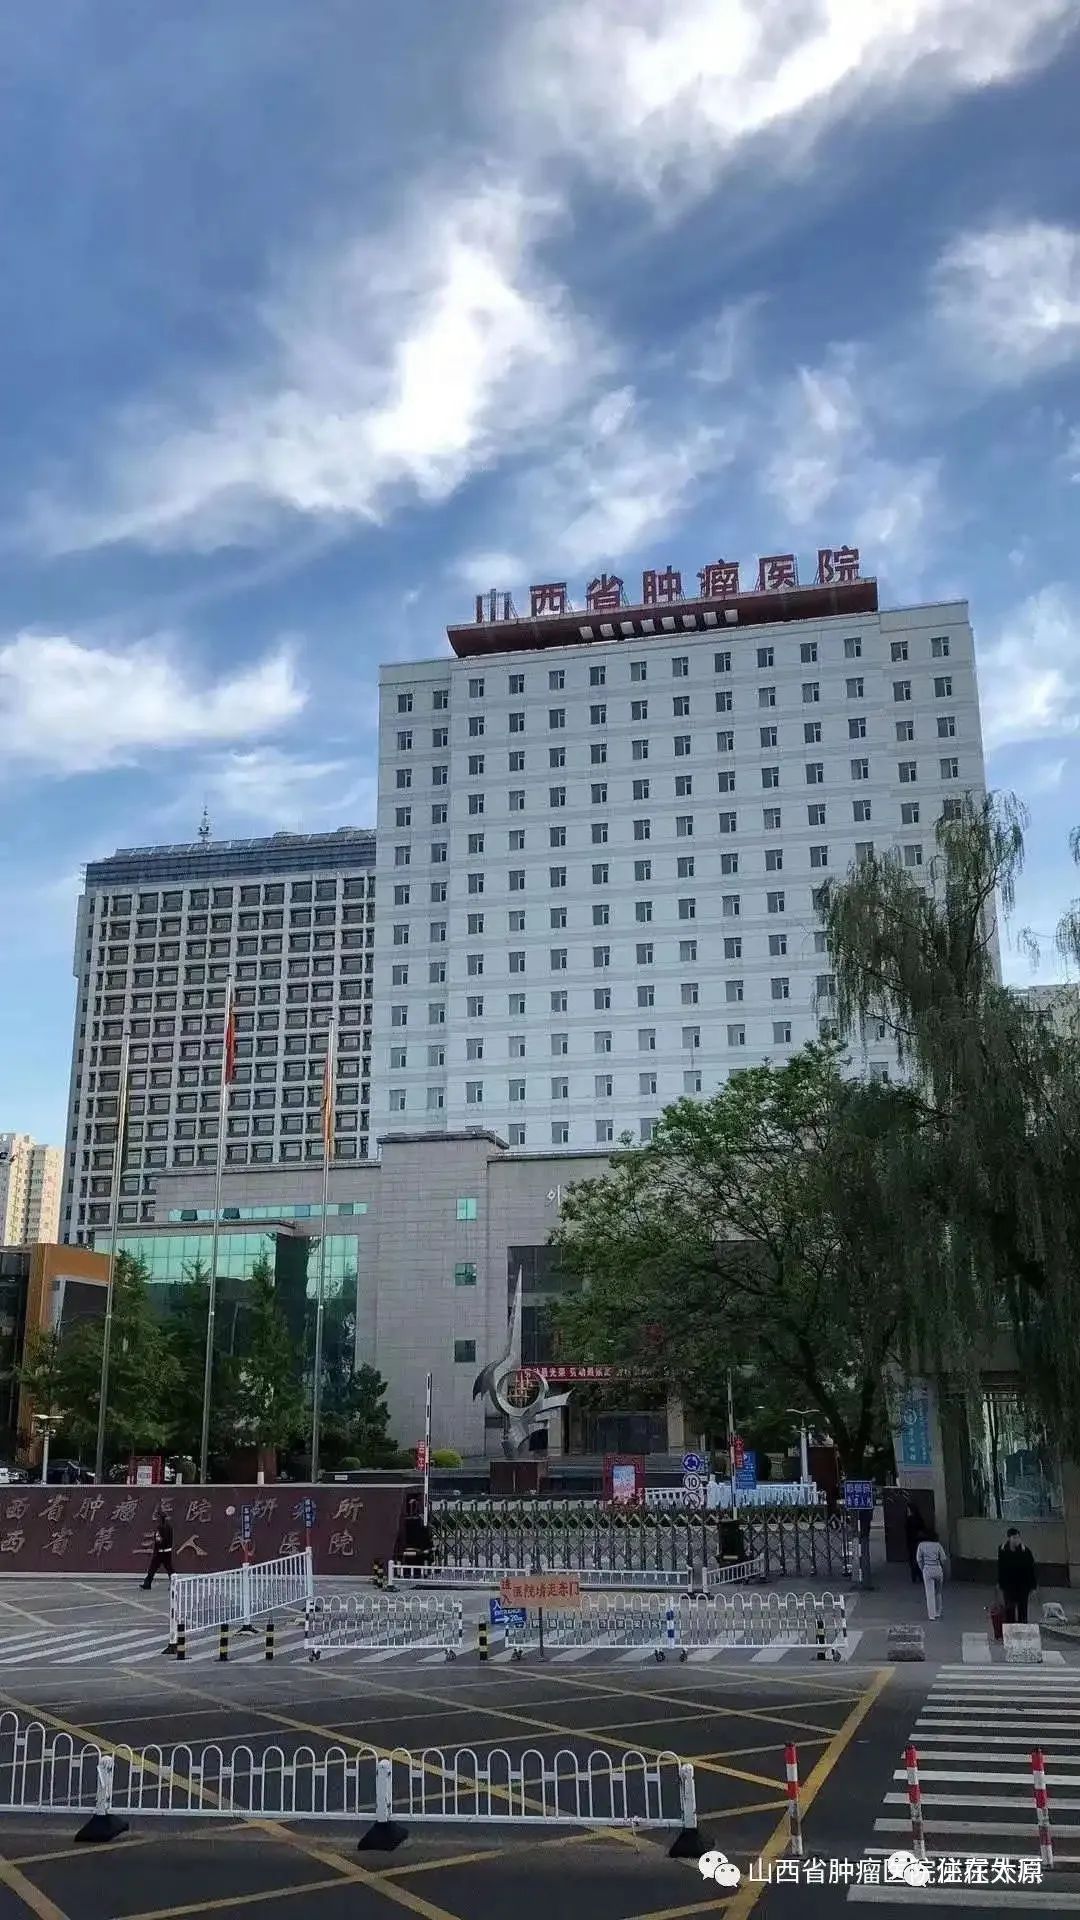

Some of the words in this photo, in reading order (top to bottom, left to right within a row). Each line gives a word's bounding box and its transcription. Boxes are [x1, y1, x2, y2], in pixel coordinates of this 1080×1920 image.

[475, 545, 860, 623] 山西省肿瘤医院
[687, 1477, 698, 1488] 10
